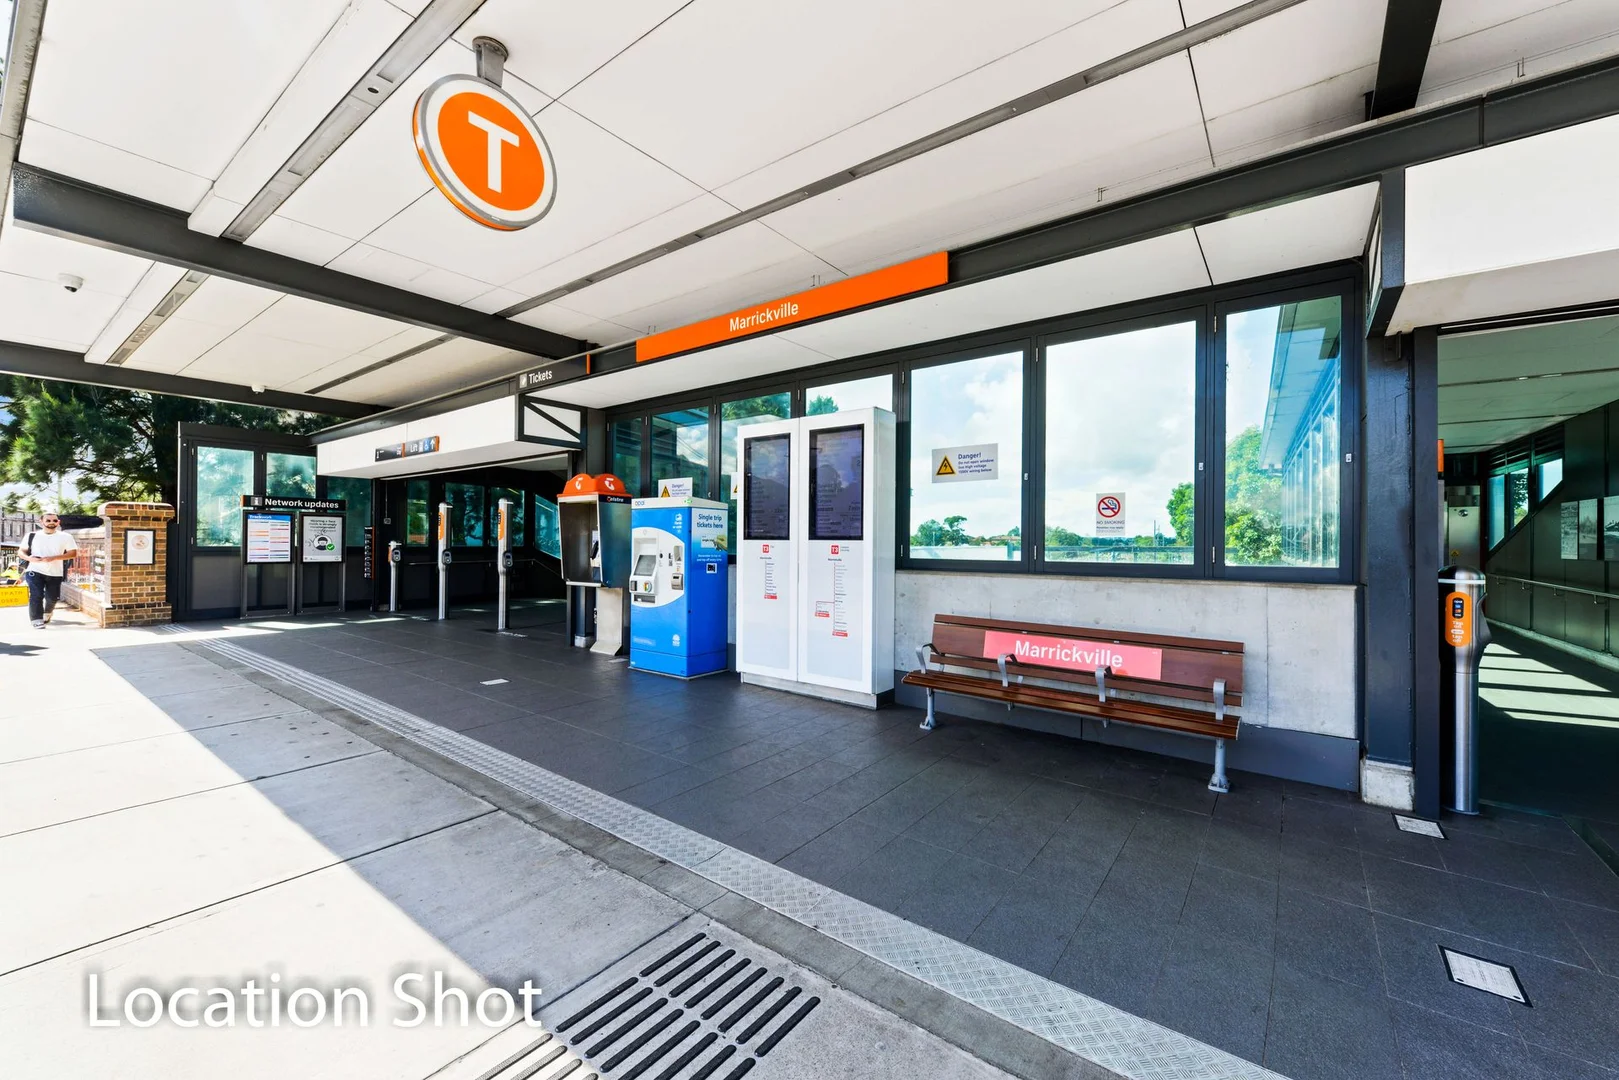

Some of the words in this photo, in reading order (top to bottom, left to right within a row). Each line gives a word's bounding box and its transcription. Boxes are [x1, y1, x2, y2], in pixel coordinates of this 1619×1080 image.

[467, 110, 519, 193] T
[729, 302, 799, 332] Marrickville
[528, 370, 553, 384] Tickets
[410, 443, 418, 453] Lift
[958, 452, 982, 460] Danger!
[264, 498, 304, 507] Network
[304, 499, 339, 509] updates
[698, 513, 713, 521] Single
[713, 514, 722, 522] trip
[1014, 639, 1124, 668] Marrickville
